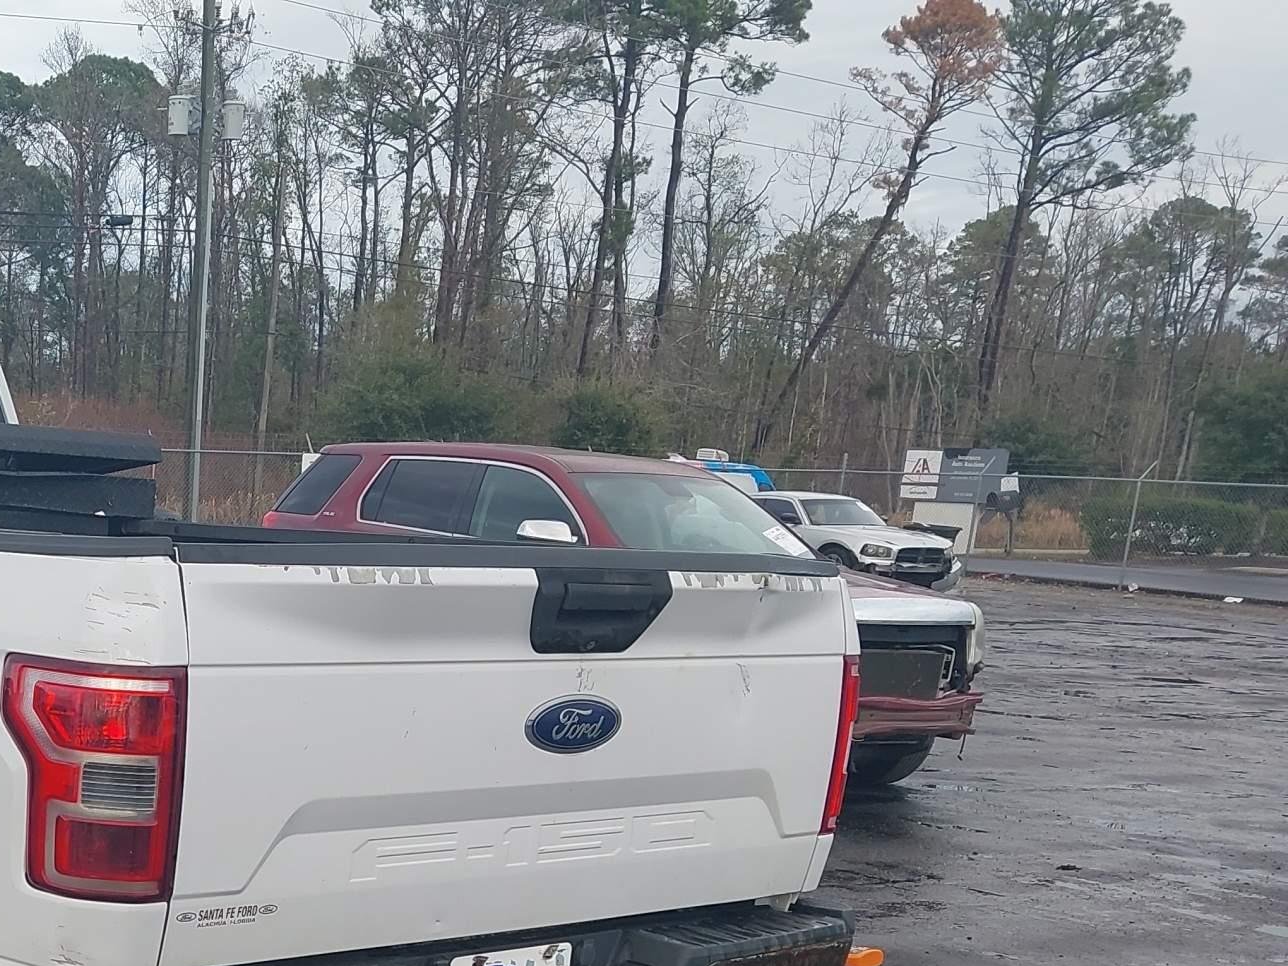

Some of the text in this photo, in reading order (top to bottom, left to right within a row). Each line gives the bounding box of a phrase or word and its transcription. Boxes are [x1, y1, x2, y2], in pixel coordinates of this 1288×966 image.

[552, 708, 604, 740] Ford
[349, 810, 714, 882] F-150
[197, 908, 224, 921] SANTA
[225, 906, 236, 919] FE
[237, 905, 258, 917] FORD
[197, 920, 227, 928] ALACHUA
